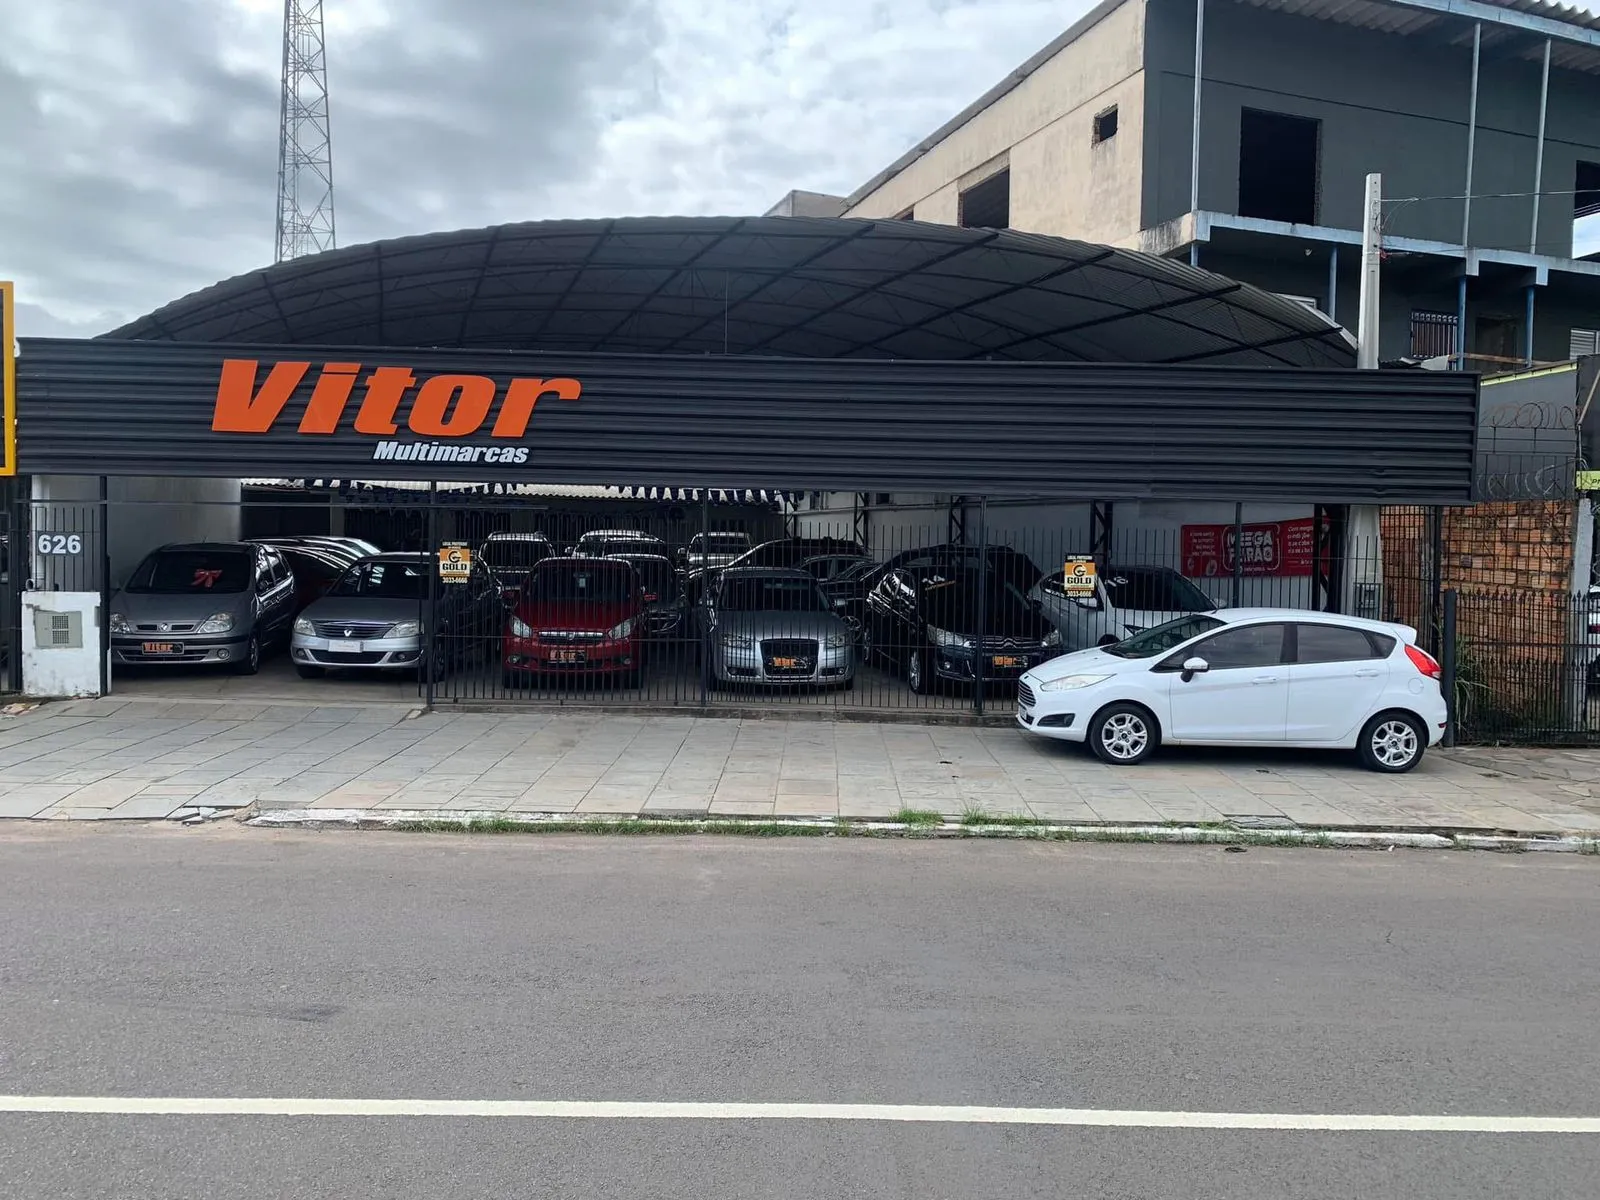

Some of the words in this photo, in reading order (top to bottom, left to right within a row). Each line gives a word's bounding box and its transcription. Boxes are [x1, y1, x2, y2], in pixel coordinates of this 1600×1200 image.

[211, 358, 582, 438] Vitor
[373, 440, 530, 464] Multimarcas
[38, 534, 82, 554] 626
[1228, 545, 1273, 563] FIRÃO
[442, 563, 467, 571] GOLD
[1067, 576, 1092, 585] GOLD
